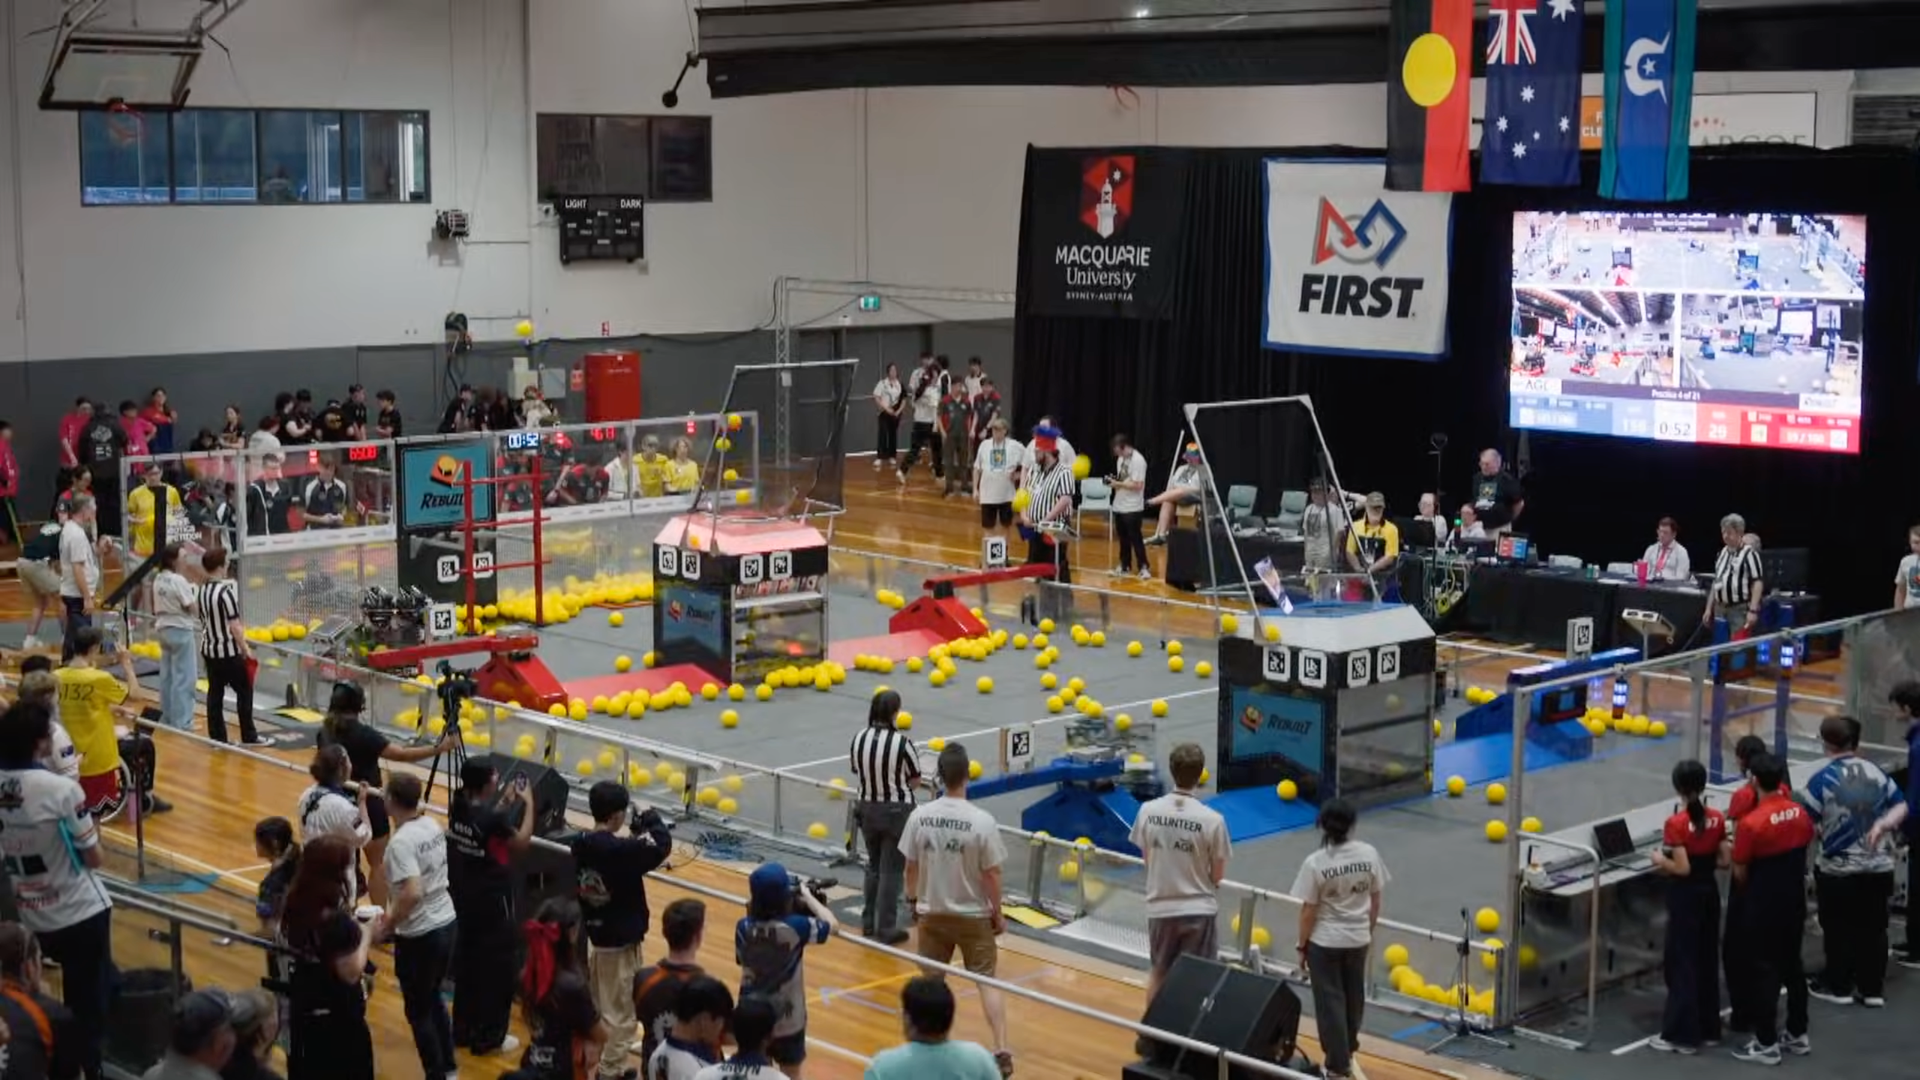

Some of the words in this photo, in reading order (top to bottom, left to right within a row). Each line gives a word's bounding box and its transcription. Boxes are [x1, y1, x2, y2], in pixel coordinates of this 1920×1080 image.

[565, 199, 587, 209] LIGHT
[620, 199, 642, 209] DARK
[1055, 245, 1151, 269] MACQUARIE
[1066, 266, 1136, 290] Universty
[1298, 273, 1425, 319] FIRST
[508, 433, 540, 449] 00:52
[420, 492, 465, 510] REBUIL
[919, 816, 972, 832] VOLUNTEER
[1147, 815, 1202, 832] VOLUNTEER
[1688, 816, 1719, 832] 697
[1769, 806, 1800, 825] 6497
